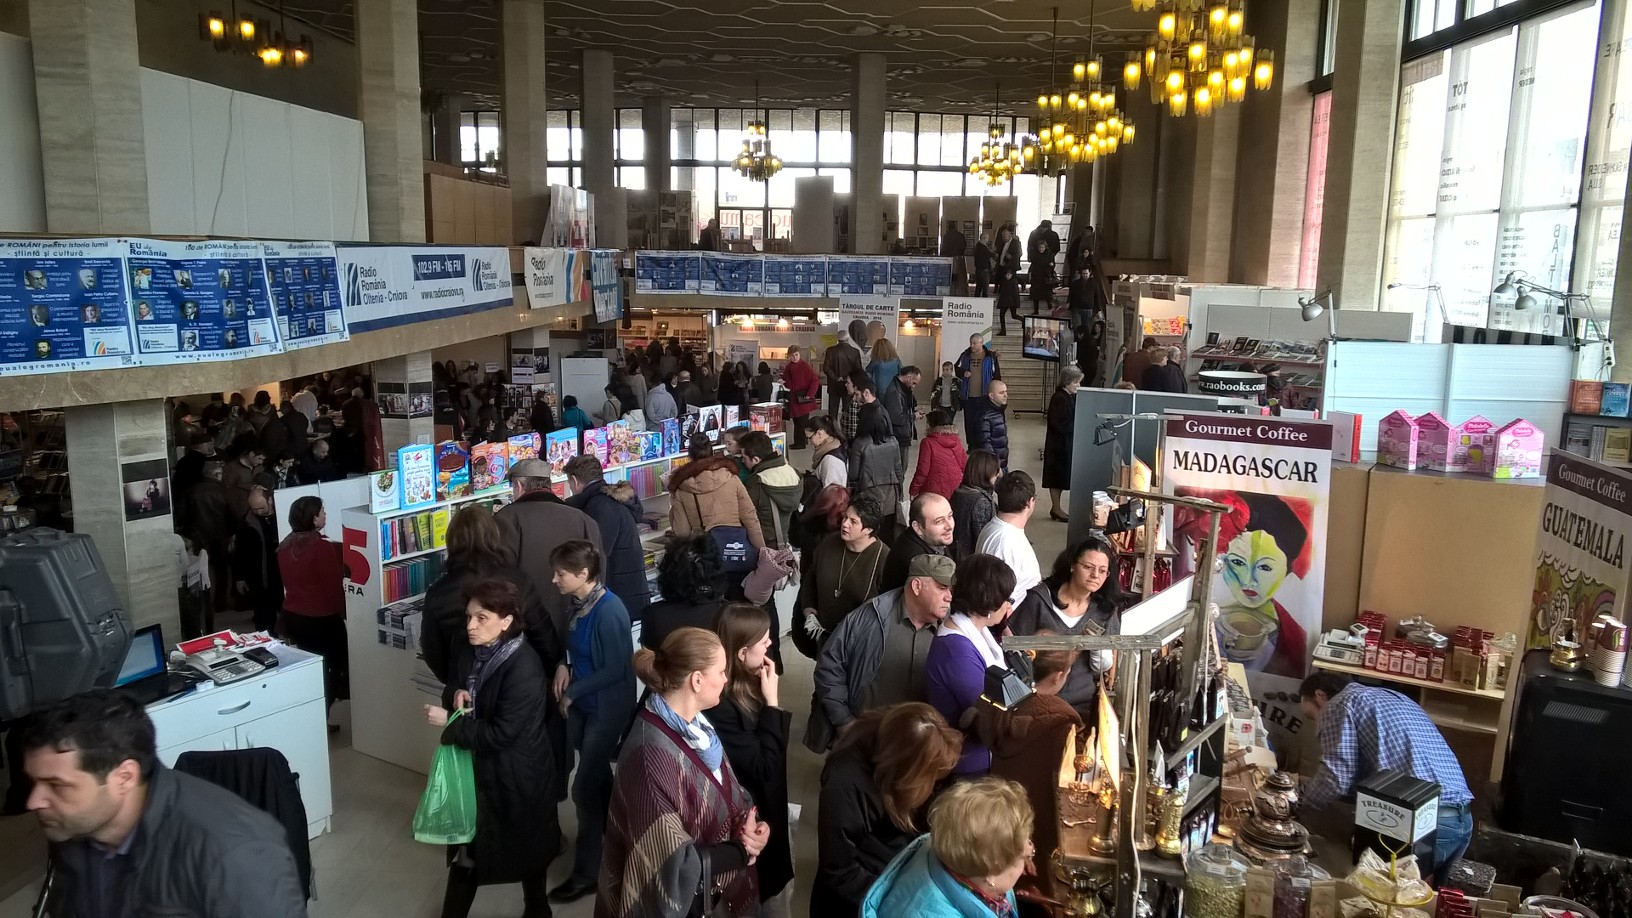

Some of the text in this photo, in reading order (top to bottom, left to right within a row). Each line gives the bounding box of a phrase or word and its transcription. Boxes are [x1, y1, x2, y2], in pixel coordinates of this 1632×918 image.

[129, 242, 142, 250] EU
[129, 248, 168, 258] România
[432, 260, 442, 272] FM
[453, 259, 462, 272] FM
[481, 260, 492, 270] Radio
[359, 266, 378, 279] Radio
[360, 279, 387, 292] România
[362, 291, 384, 305] Oltenia
[387, 289, 408, 303] Craiova
[947, 302, 973, 310] Radio
[947, 309, 985, 319] România
[1185, 420, 1308, 442] Gourmet Coffee
[1173, 449, 1318, 483] MADAGASCAR
[1558, 463, 1627, 503] Gourmet Coffee
[1542, 502, 1624, 570] GUATEMALA
[1361, 800, 1406, 821] TREASURE
